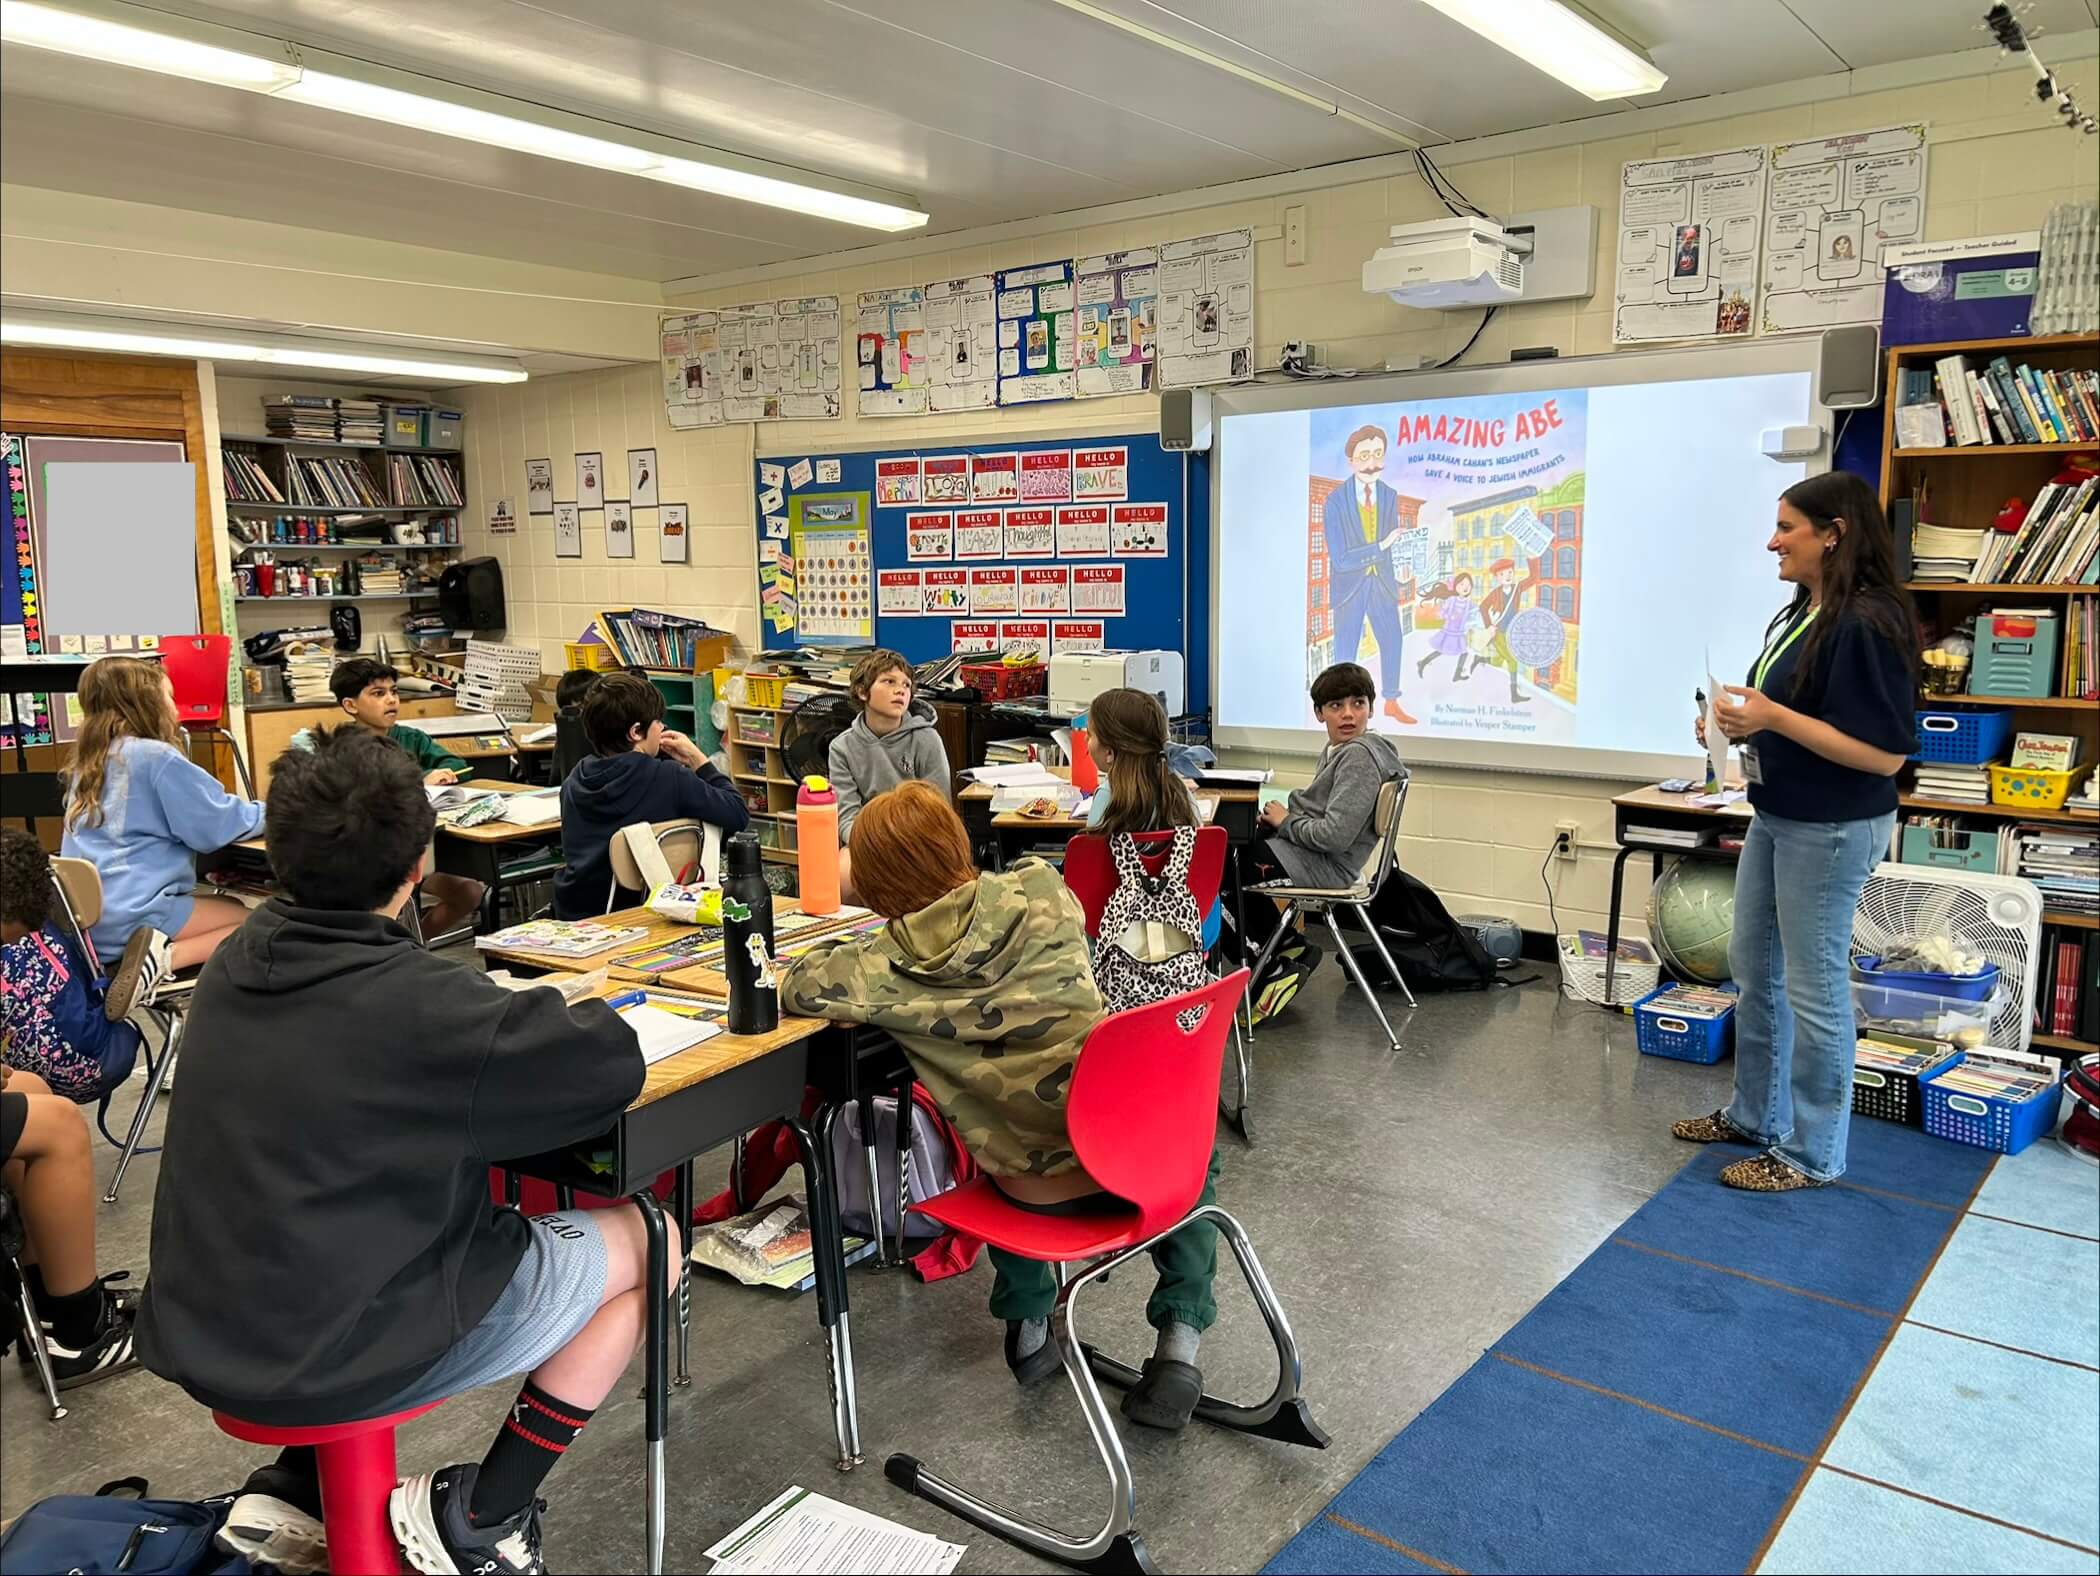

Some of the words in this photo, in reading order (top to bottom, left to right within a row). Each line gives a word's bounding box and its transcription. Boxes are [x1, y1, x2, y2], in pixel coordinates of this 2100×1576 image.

[1397, 414, 1505, 448] AMAZING
[1515, 399, 1563, 442] ABE
[1030, 455, 1060, 465] HELLO
[1084, 452, 1116, 462] HELLO
[1408, 453, 1424, 464] HOW
[1426, 452, 1461, 466] ABRAHAM
[1495, 448, 1540, 466] NEWSPAPER
[1453, 473, 1473, 484] VOICE
[1477, 475, 1487, 485] TO
[1489, 472, 1516, 484] JEWISH
[1518, 454, 1565, 479] IMMIGRANTS
[1076, 469, 1118, 491] BRAVE
[1015, 512, 1044, 521] HELLO
[1068, 510, 1098, 519] HELLO
[1124, 508, 1156, 518] HELLO
[916, 516, 943, 525] HELLO
[965, 514, 993, 523] HELLO
[888, 573, 913, 581] HELLO
[932, 572, 959, 580] HELLO
[980, 571, 1007, 580] HELLO
[1029, 571, 1058, 579] HELLO
[1083, 569, 1113, 578] HELLO
[962, 625, 989, 633] HELLO
[1010, 624, 1039, 633] HELLO
[1063, 625, 1093, 633] HELLO
